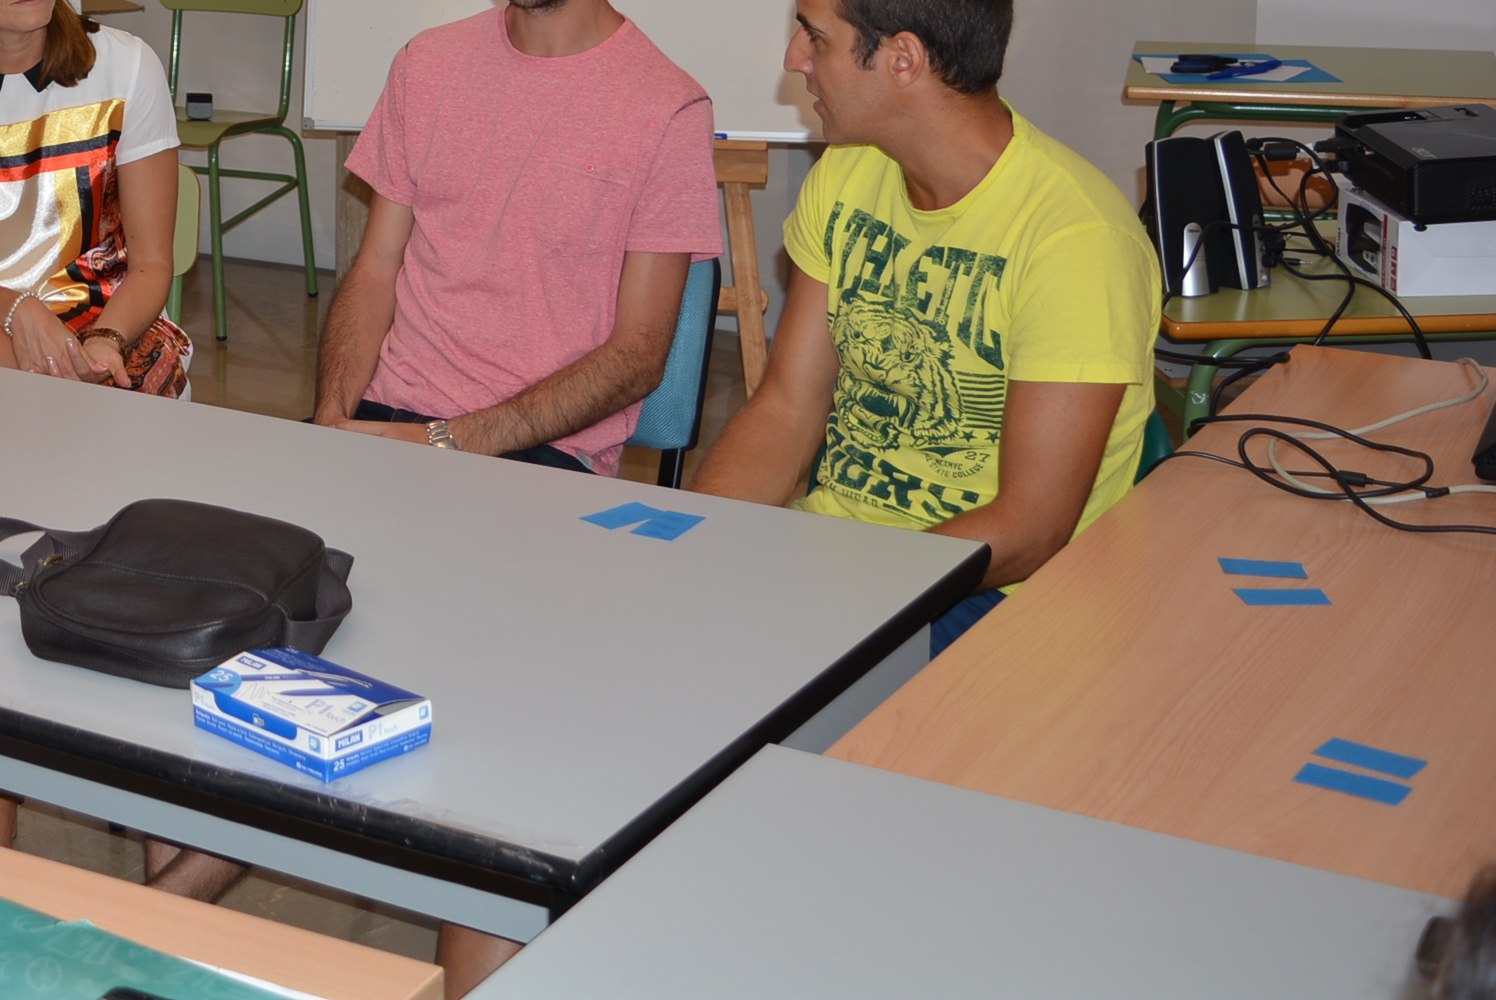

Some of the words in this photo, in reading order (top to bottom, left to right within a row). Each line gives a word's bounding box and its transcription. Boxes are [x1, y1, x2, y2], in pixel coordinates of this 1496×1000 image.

[964, 451, 991, 463] 27
[929, 462, 950, 478] STATE
[952, 463, 985, 479] COLLEGE
[239, 657, 264, 669] MILAN
[209, 669, 234, 682] 25
[304, 698, 334, 715] P1
[337, 732, 361, 750] MILAN
[368, 721, 384, 740] P1
[333, 758, 346, 773] 25
